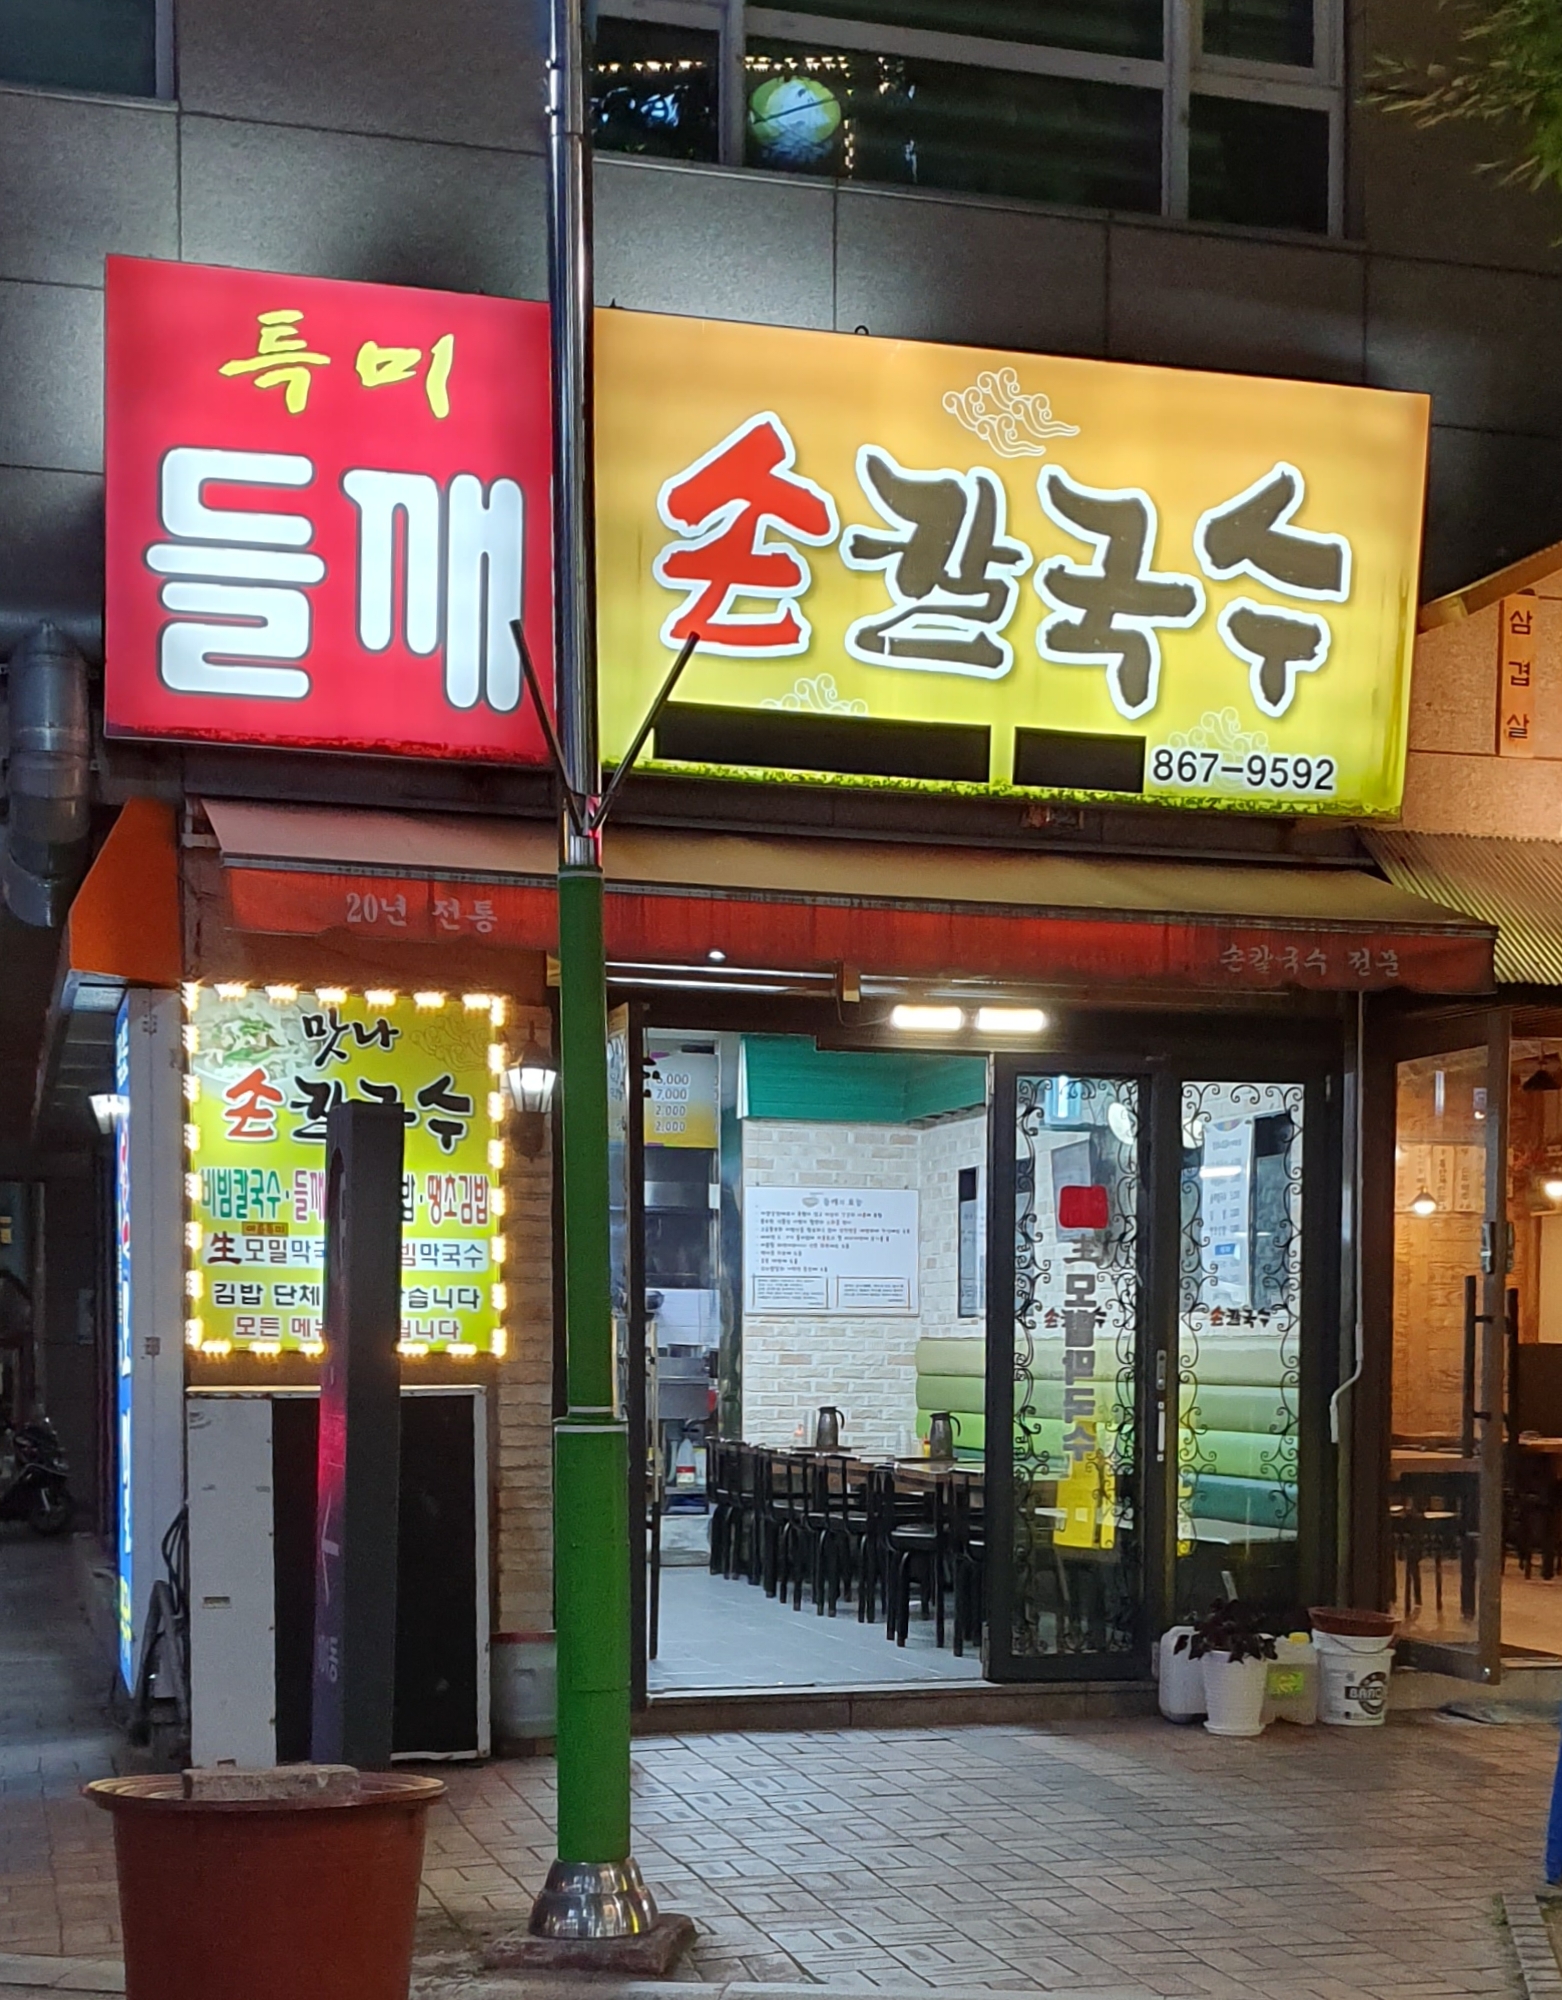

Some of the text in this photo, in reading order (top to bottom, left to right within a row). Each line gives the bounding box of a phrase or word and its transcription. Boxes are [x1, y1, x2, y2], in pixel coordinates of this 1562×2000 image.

[218, 309, 455, 420] 특미
[145, 446, 524, 712] 들깨
[659, 415, 1347, 712] 손칼국수
[1506, 610, 1533, 739] 삼겹살
[1152, 748, 1336, 791] 867-9592
[346, 892, 498, 933] 20년 전통
[1219, 942, 1400, 978] 손칼국수 전문
[302, 1007, 400, 1067] 맛나
[655, 1105, 686, 1117] 2,000
[656, 1088, 688, 1101] 7,000
[655, 1121, 686, 1133] 2,000
[214, 1283, 263, 1305] 김밥
[401, 1287, 480, 1310] 습니다
[235, 1316, 280, 1337] 모든
